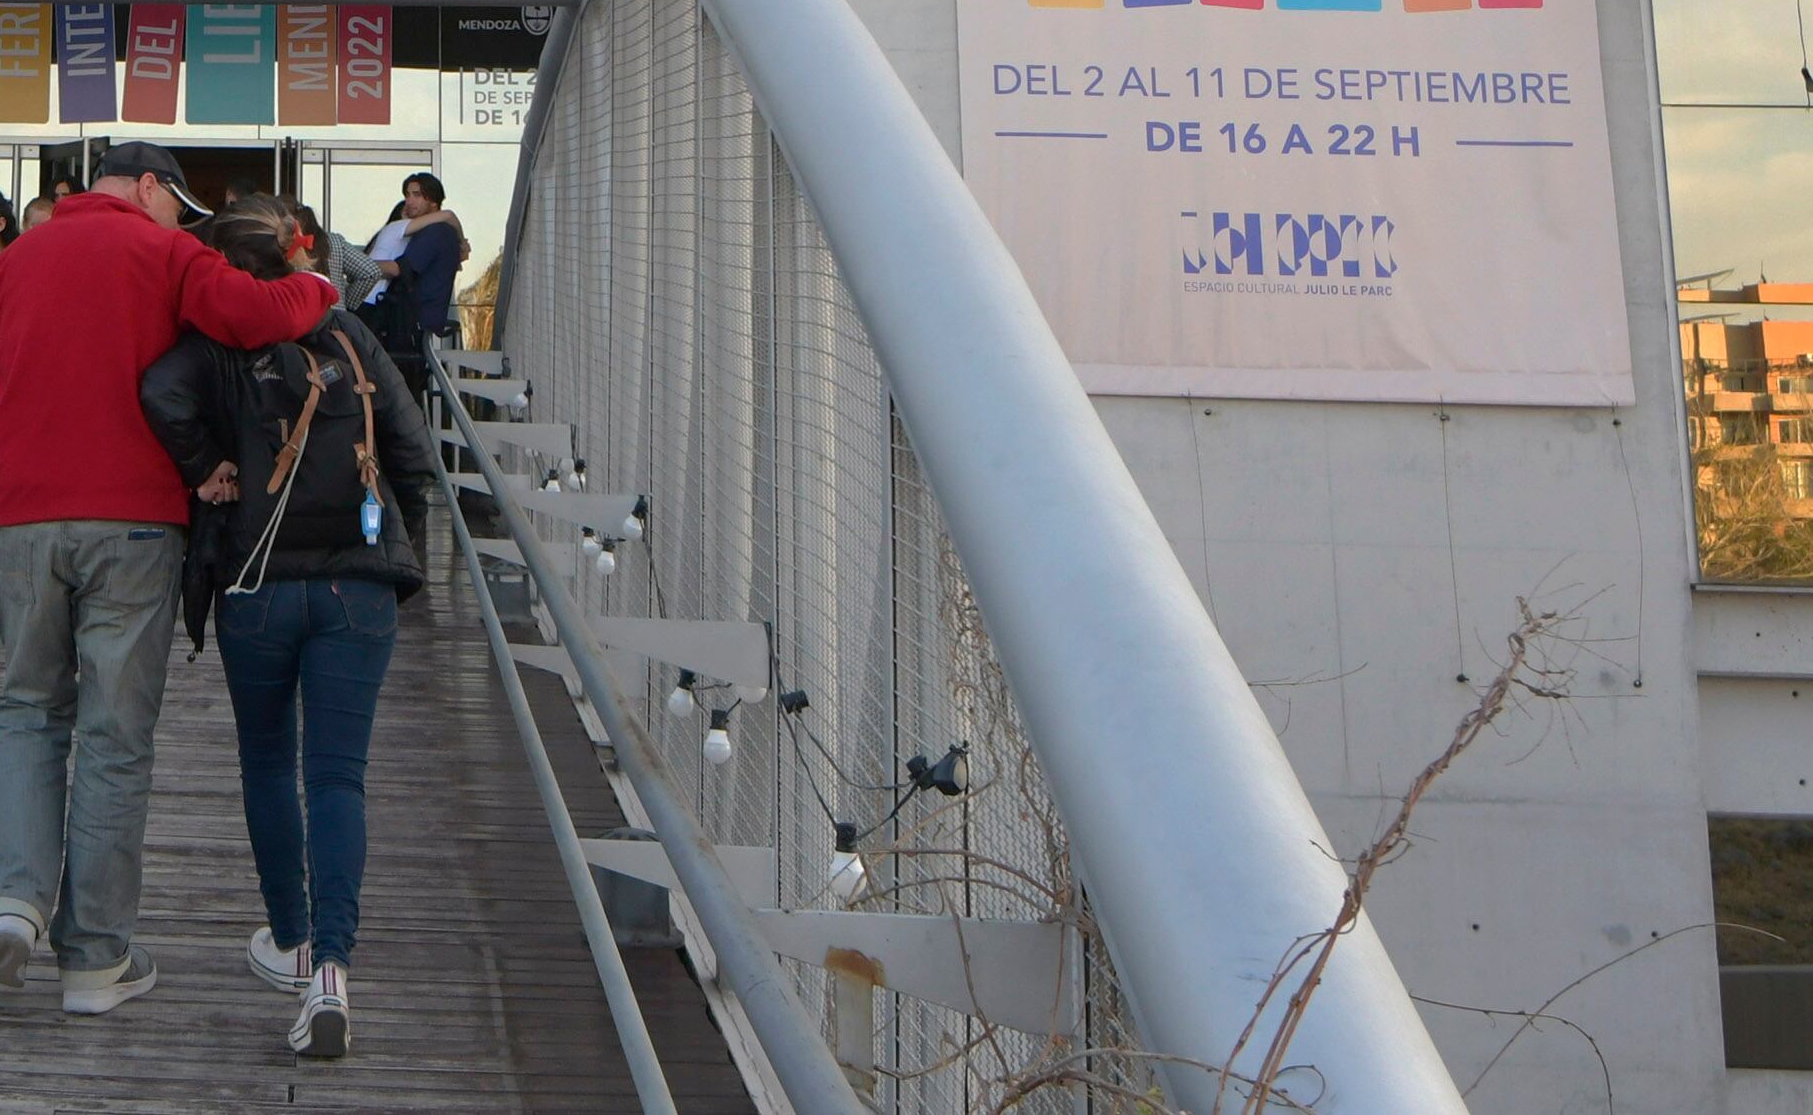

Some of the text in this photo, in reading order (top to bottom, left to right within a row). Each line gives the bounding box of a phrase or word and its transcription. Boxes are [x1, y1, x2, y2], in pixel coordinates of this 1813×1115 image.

[458, 19, 521, 30] MENDOZA
[131, 18, 178, 80] DEL
[346, 15, 384, 99] 2022
[474, 67, 519, 85] DEL
[992, 63, 1572, 104] DEL 2 AL 11 DE SEPTIEMBRE
[474, 90, 497, 104] DE
[474, 109, 503, 125] DE
[1145, 121, 1421, 157] DE 16 A 22 H
[1183, 281, 1393, 296] ESPACIO CULTURAL JULIO LE PARC
